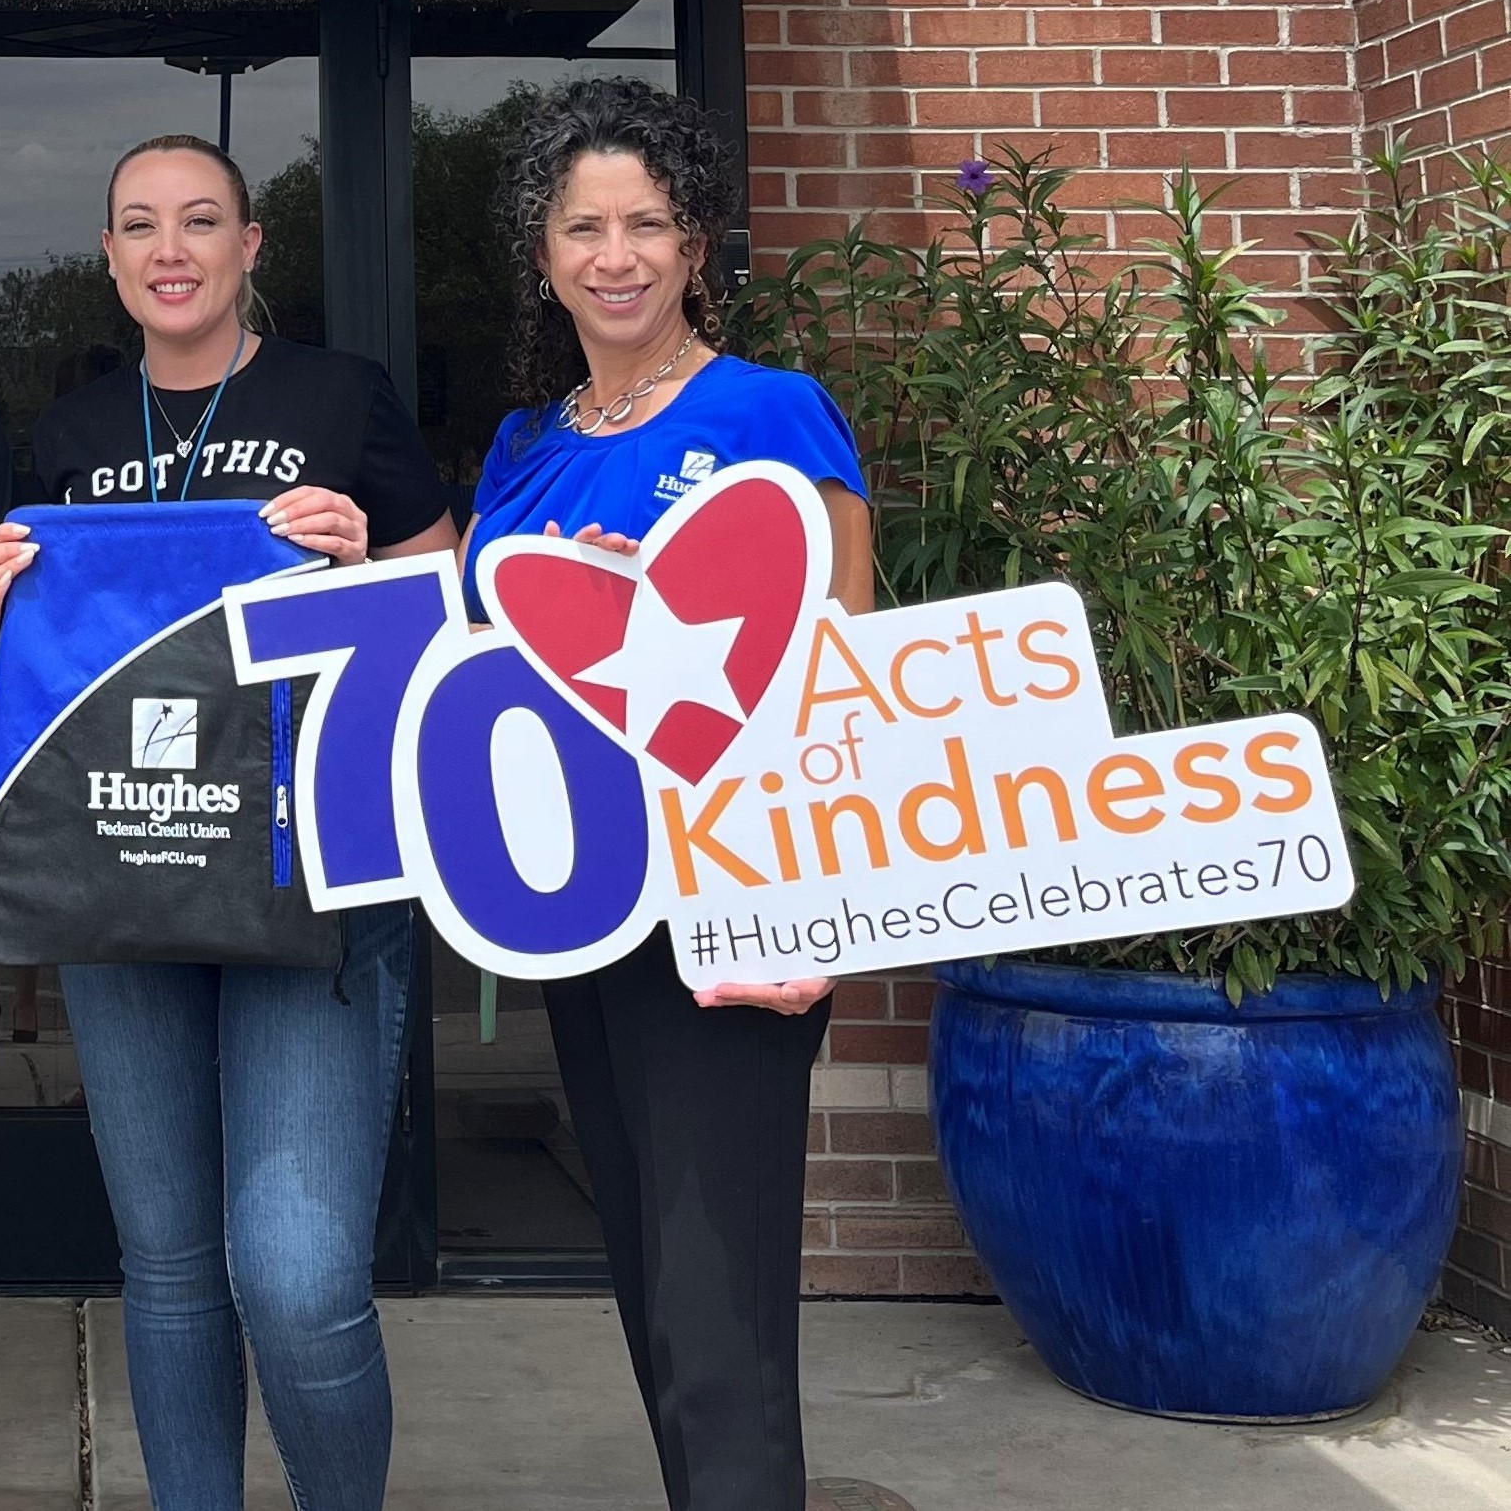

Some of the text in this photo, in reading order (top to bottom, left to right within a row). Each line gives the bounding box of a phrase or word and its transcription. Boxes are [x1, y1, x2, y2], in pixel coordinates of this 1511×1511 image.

[91, 440, 306, 497] GOT THIS
[794, 611, 1081, 738] Acts
[241, 572, 649, 954] 70
[799, 710, 864, 785] of
[87, 771, 241, 822] Hughes
[96, 820, 231, 839] Federal Credit Union
[659, 733, 1313, 897] Kindness
[120, 850, 207, 868] HughesFCU.org
[690, 834, 1331, 966] #HughesCelebrates70
